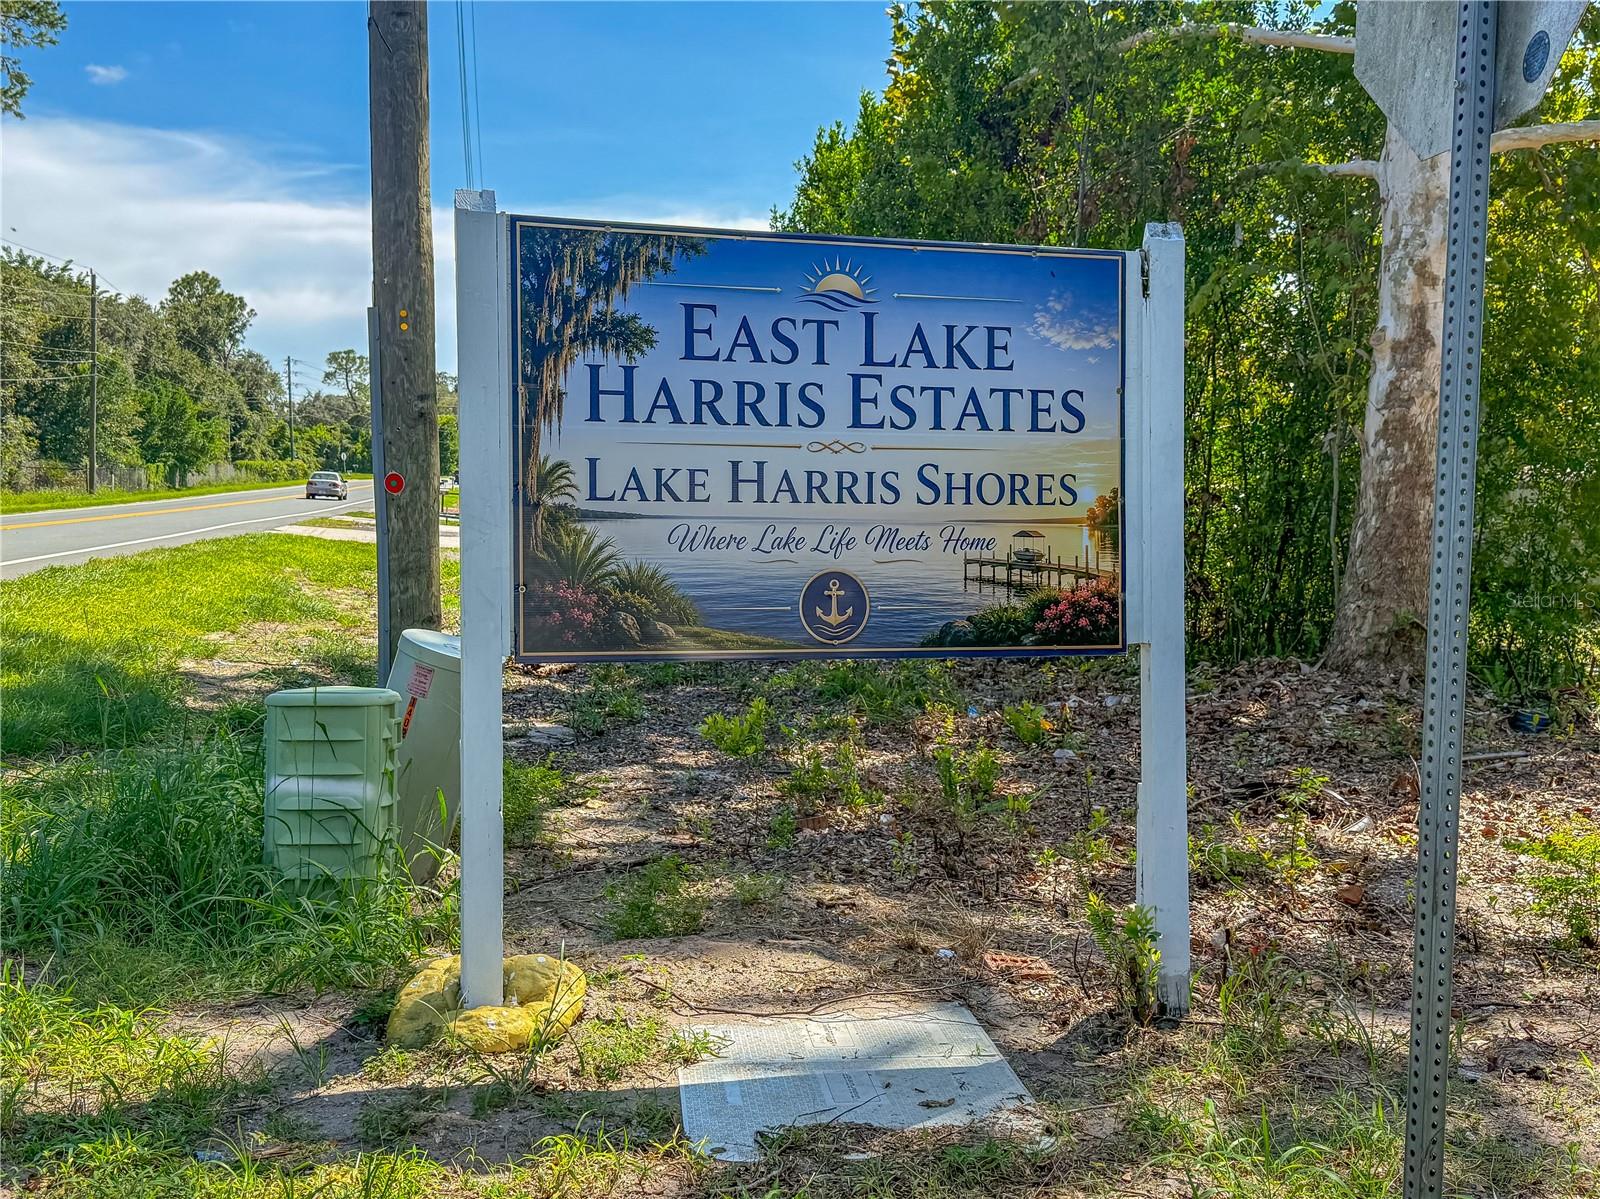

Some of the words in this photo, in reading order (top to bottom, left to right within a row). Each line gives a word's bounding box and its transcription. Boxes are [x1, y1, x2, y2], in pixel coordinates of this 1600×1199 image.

[679, 302, 840, 366] EAST
[859, 311, 1015, 372] LAKE
[583, 363, 826, 429] HARRIS
[846, 372, 1086, 434] ESTATES
[584, 457, 711, 503] LAKE
[727, 460, 901, 506] HARRIS
[916, 462, 1078, 507] SHORES
[667, 523, 748, 553] Where
[751, 523, 807, 554] Lake
[810, 524, 858, 560] Life
[864, 524, 934, 554] Meets
[938, 524, 998, 555] Home
